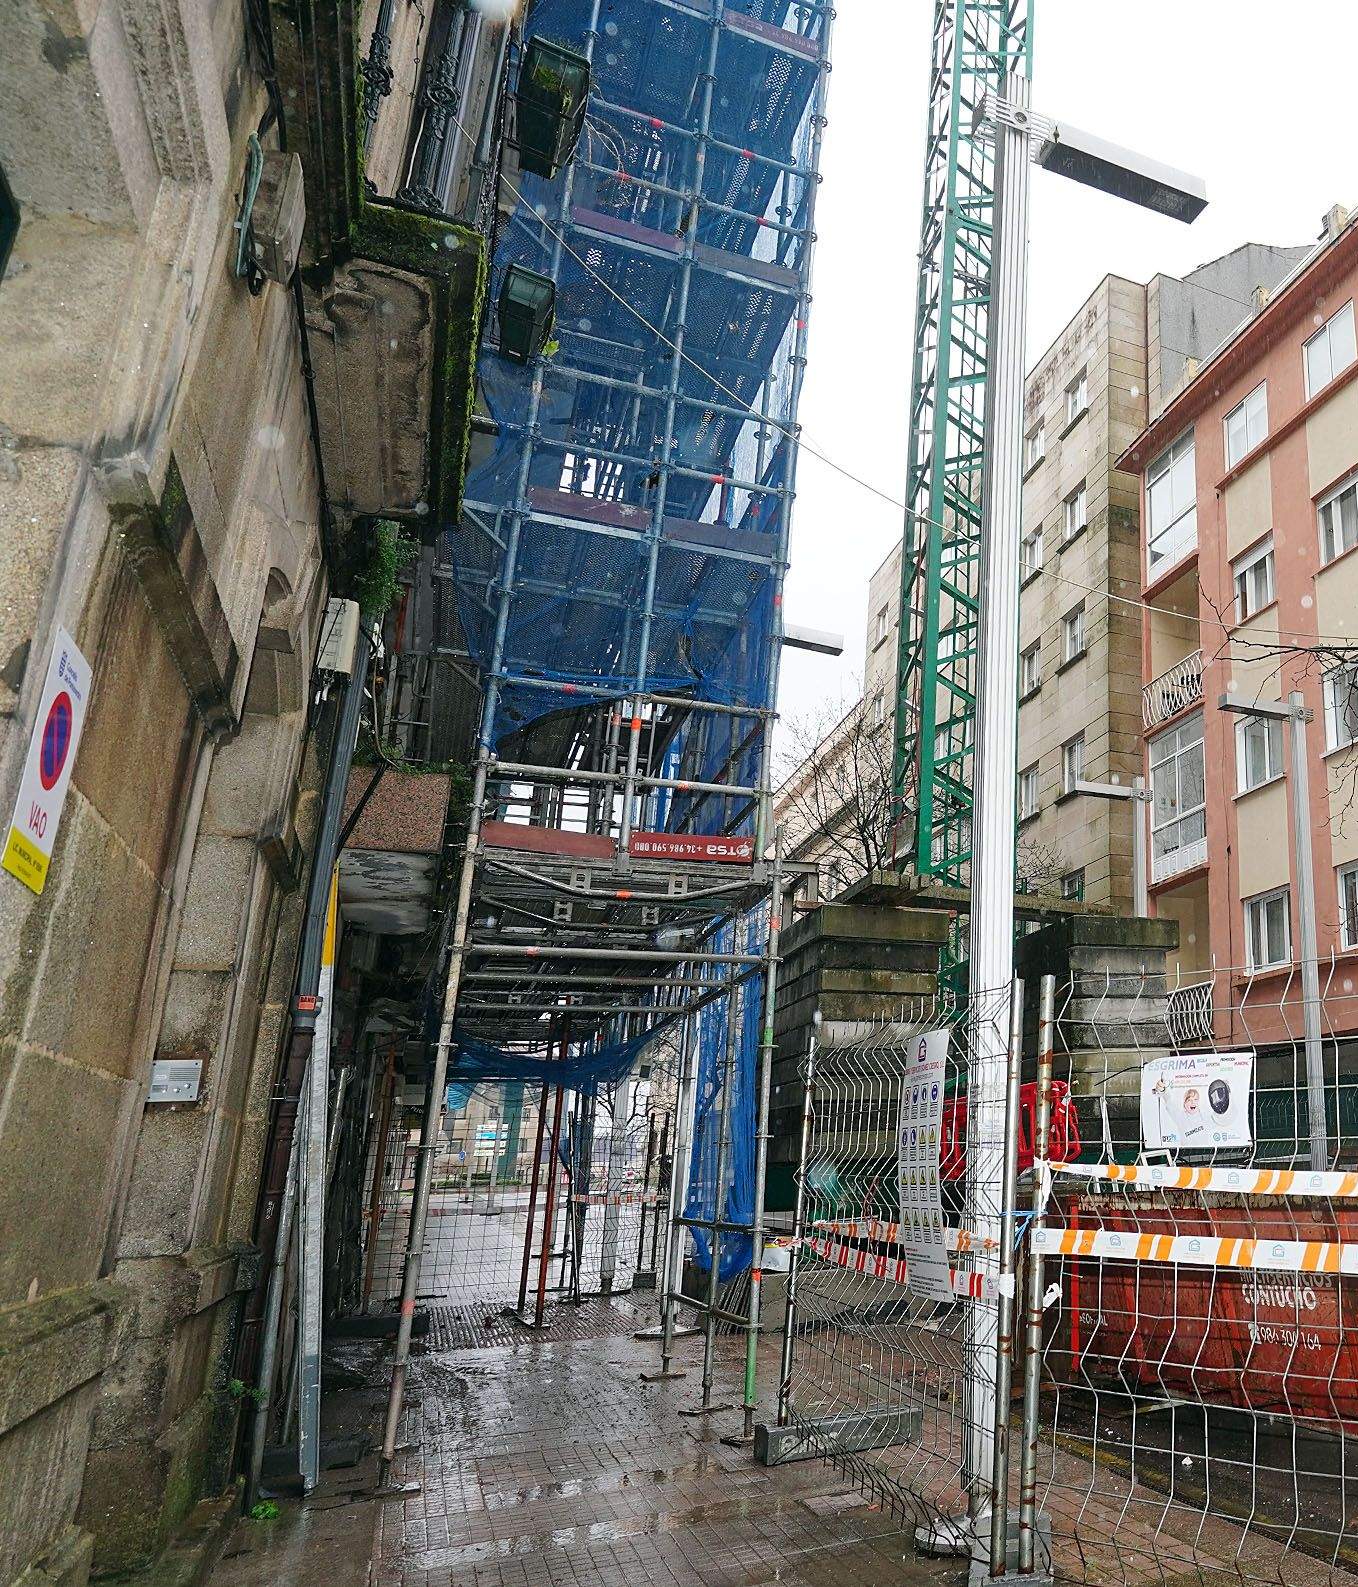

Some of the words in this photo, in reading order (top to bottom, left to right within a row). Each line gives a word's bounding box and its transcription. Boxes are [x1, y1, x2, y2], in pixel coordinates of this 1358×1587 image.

[28, 801, 48, 839] VAO
[1148, 1059, 1196, 1071] ESGRIMA
[1301, 1331, 1322, 1350] 164
